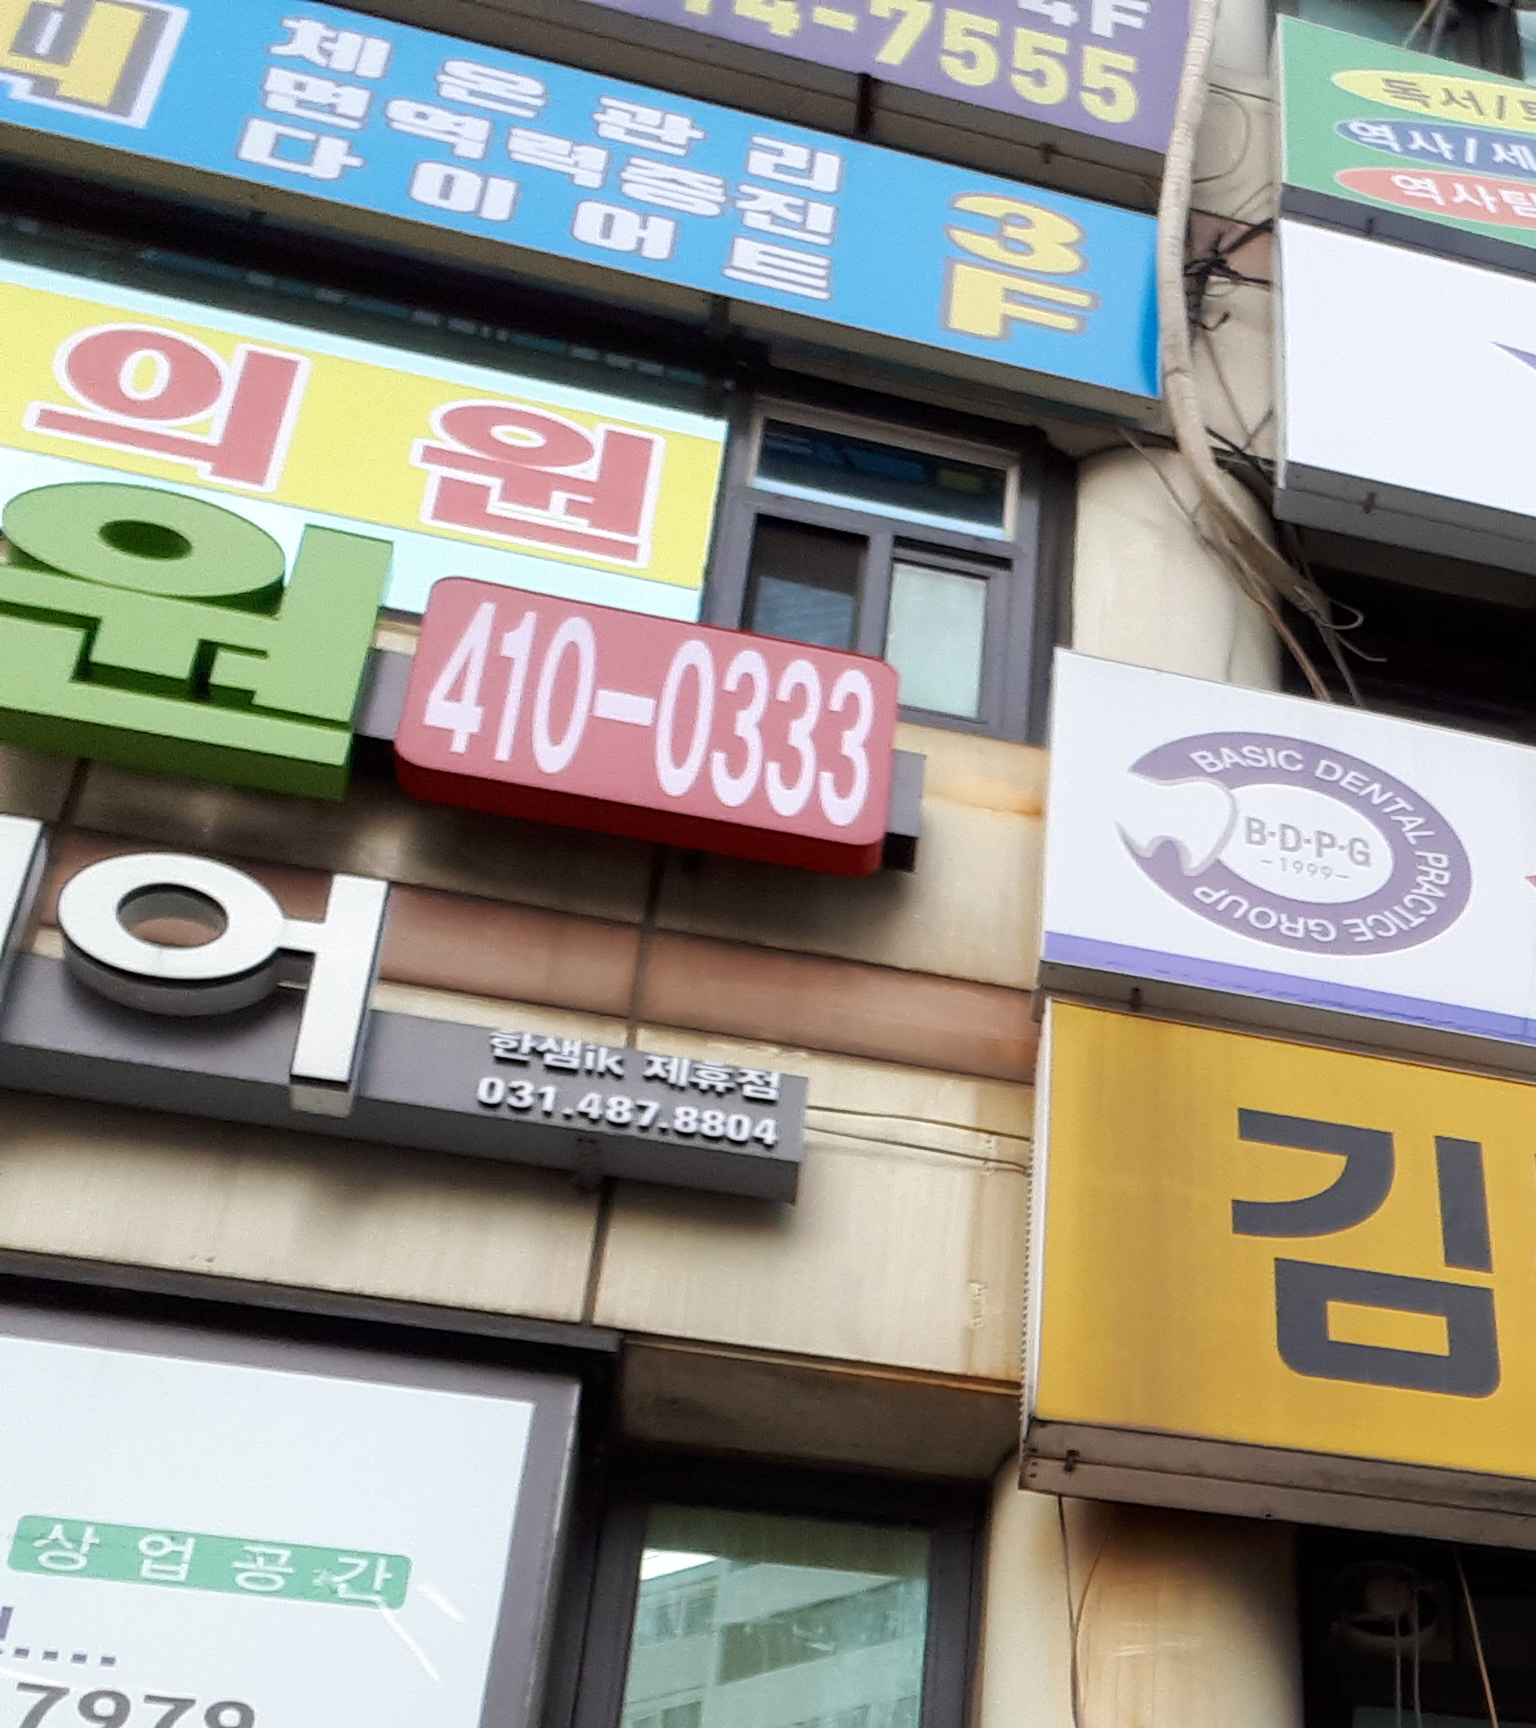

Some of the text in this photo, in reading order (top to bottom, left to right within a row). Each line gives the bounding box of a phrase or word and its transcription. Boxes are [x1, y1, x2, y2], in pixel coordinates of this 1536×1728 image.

[683, 0, 1138, 122] 4-7555
[426, 601, 875, 829] 410-0333
[1190, 745, 1451, 943] BASIC DENTAL PRACTICE GROUP
[0, 815, 389, 1082] 어
[477, 1074, 780, 1147] 031.487.8804
[489, 1029, 784, 1103] 한샘ik 제휴점
[32, 1522, 394, 1600] 상업공간
